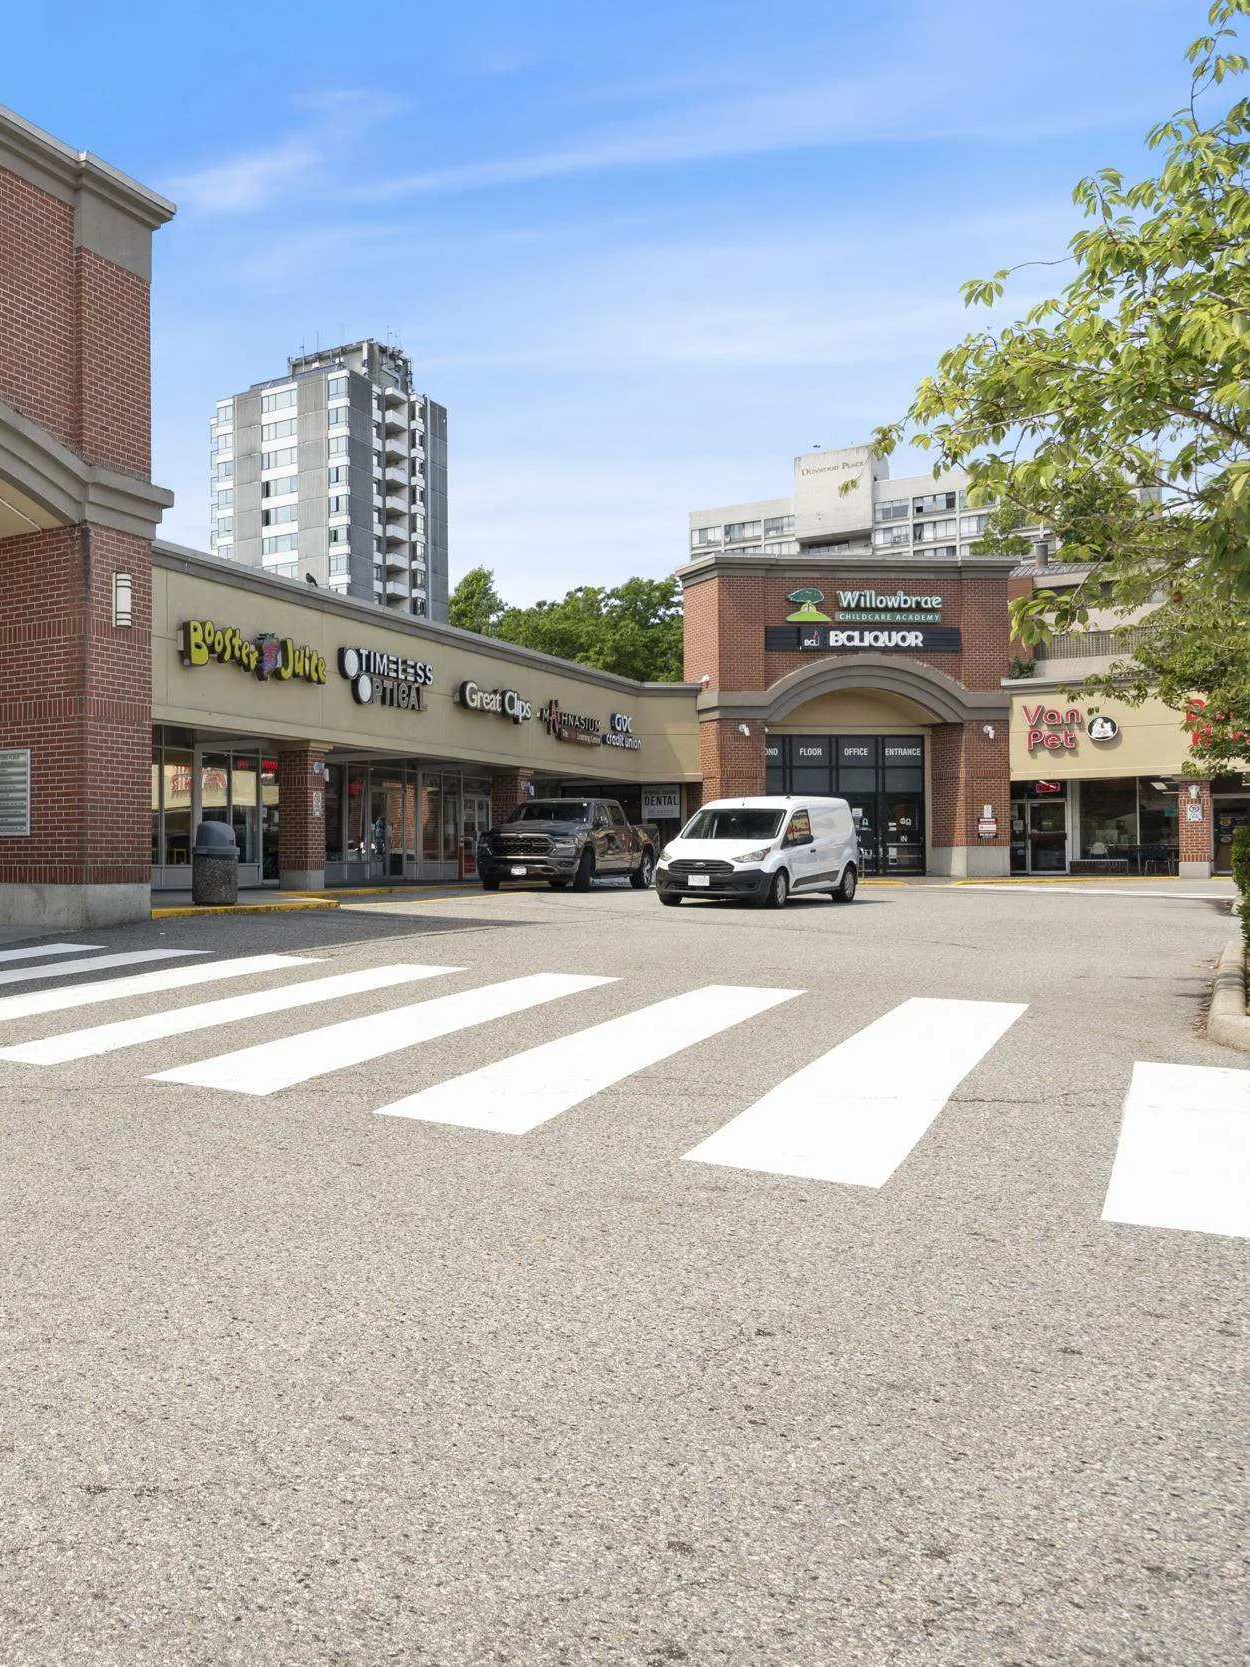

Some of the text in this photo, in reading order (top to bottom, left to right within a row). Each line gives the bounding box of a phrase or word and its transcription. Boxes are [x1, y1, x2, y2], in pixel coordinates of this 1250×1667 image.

[837, 590, 943, 609] Willowbrae
[839, 613, 941, 621] CHILDCARE ACADEMY
[828, 630, 924, 648] BCLIQUOR
[186, 620, 327, 684] Booster Juice
[359, 648, 434, 685] TIMELESS
[465, 682, 531, 723] Great Clips
[1022, 703, 1082, 726] Van
[606, 733, 642, 750] credit union
[1026, 728, 1077, 751] Pet
[799, 747, 823, 756] FLOOR
[844, 747, 869, 756] OFFICE
[885, 747, 922, 756] ENTRANCE
[644, 795, 679, 807] DENTAL
[900, 835, 908, 843] IN
